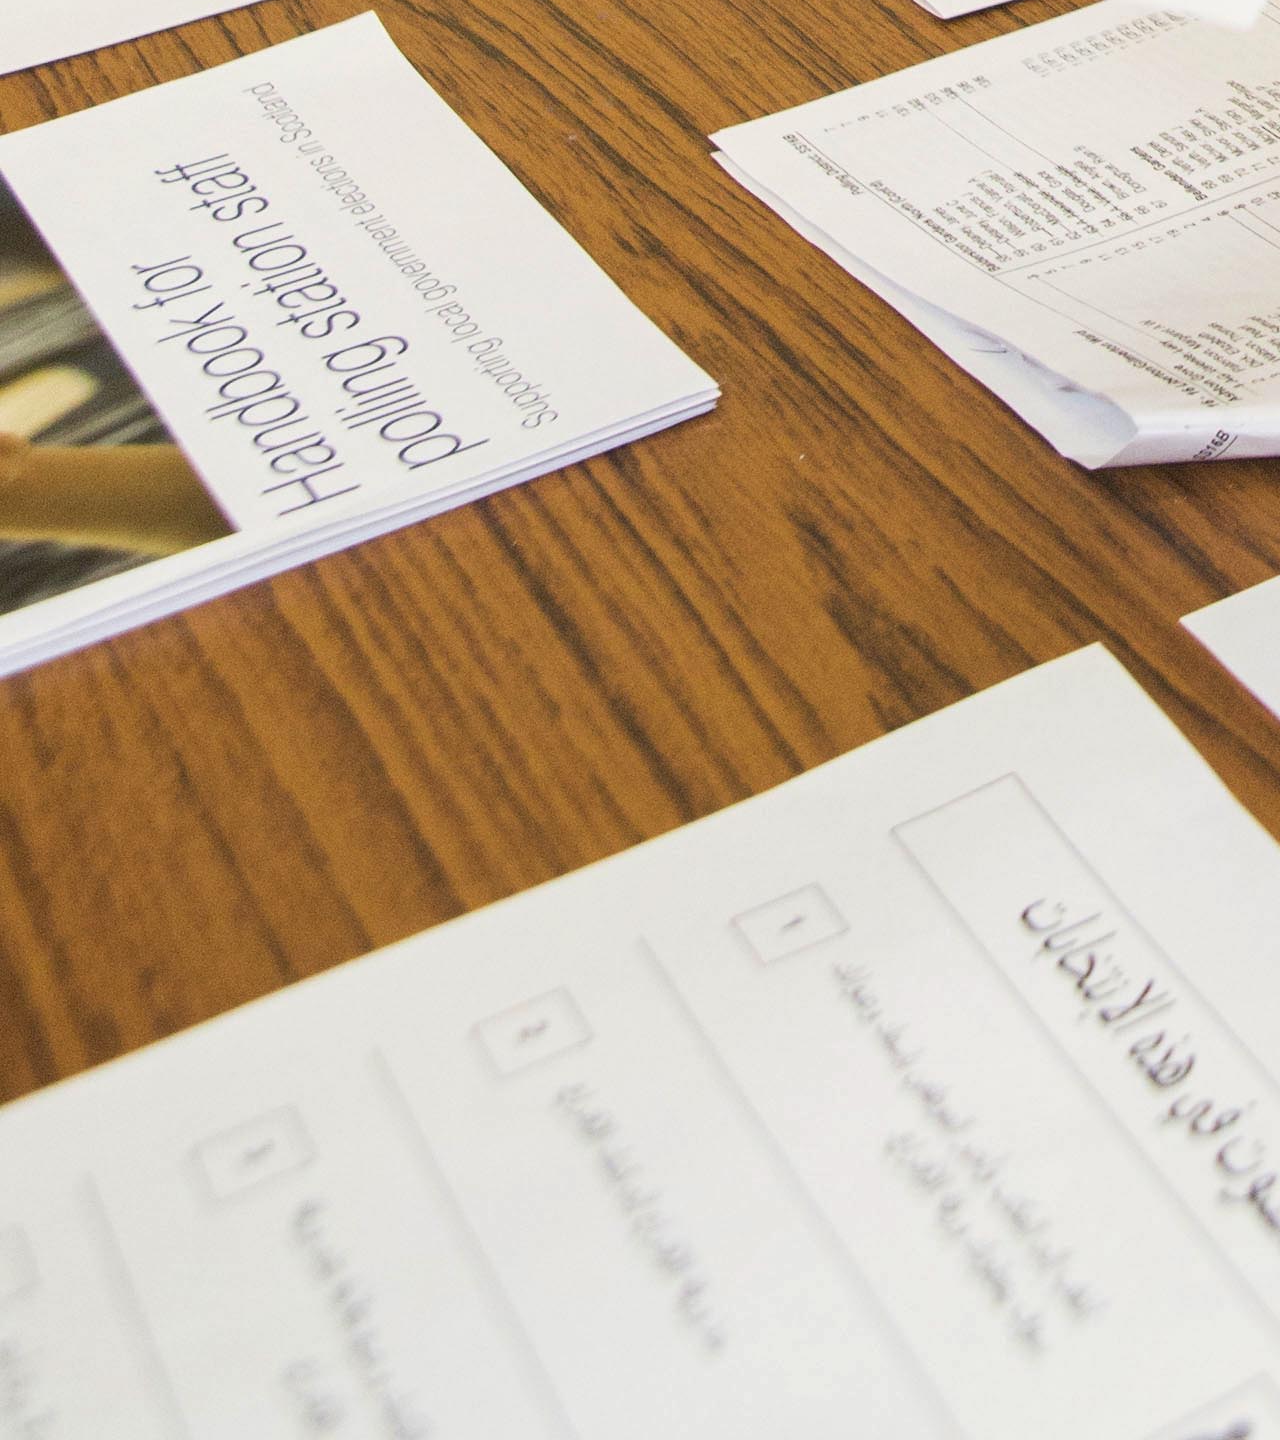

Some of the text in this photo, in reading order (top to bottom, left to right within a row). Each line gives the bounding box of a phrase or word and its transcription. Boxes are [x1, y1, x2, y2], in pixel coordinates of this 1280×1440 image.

[131, 254, 362, 516] Handbook for
[153, 153, 489, 470] polling station staff
[244, 81, 558, 430] Supporting local government elections in Scotland
